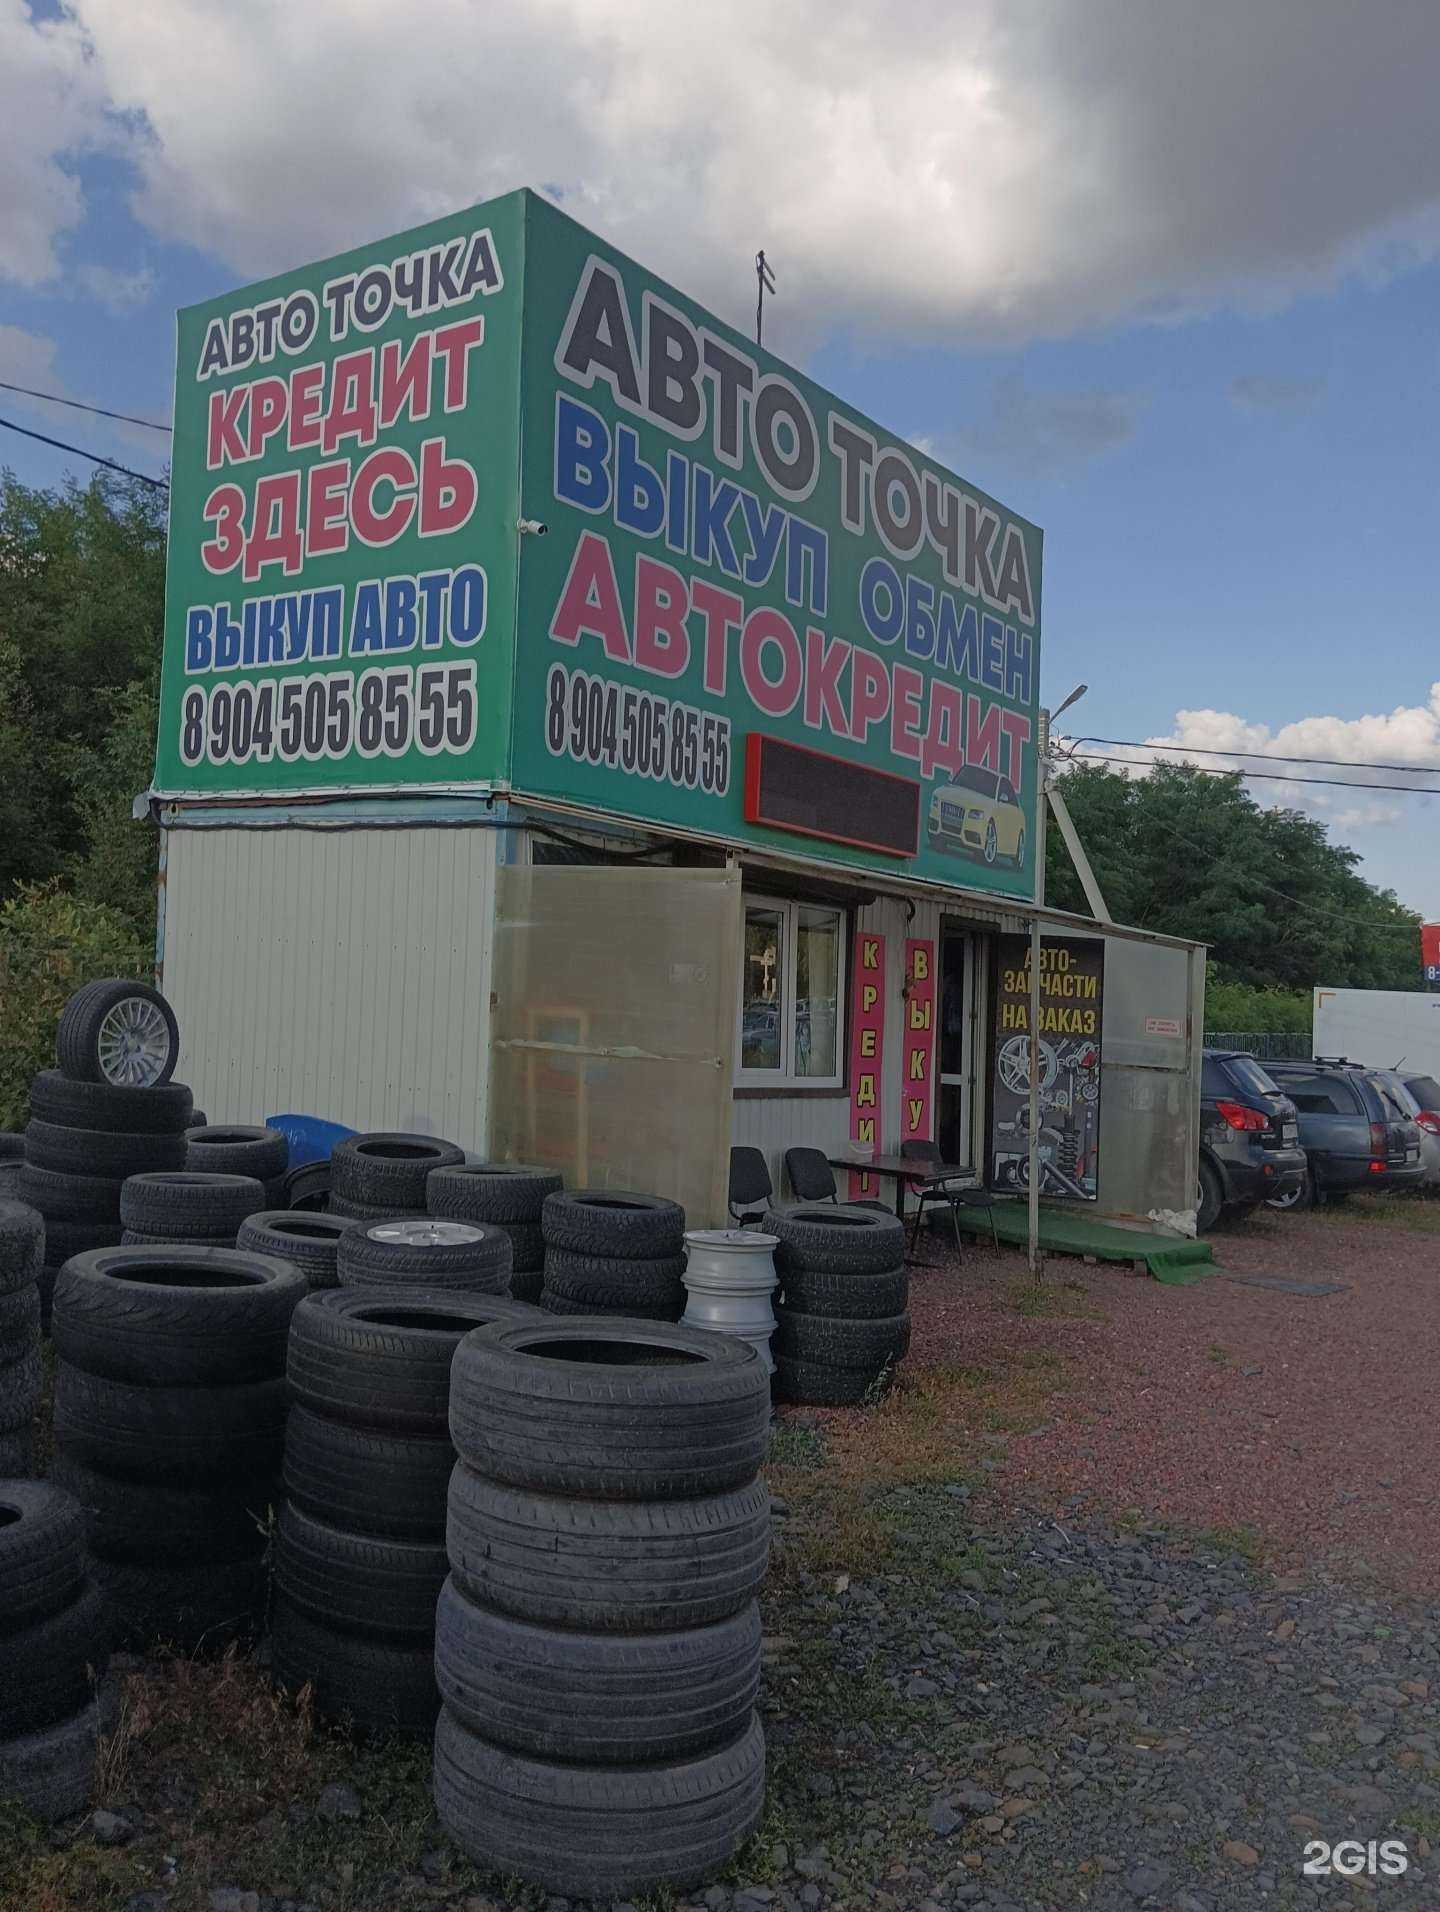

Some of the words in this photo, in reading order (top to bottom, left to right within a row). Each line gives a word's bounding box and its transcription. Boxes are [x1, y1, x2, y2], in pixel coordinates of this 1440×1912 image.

[198, 291, 317, 379] АВТО
[324, 231, 501, 340] ТОЧКА
[207, 316, 483, 469] КРЕДИТ
[556, 257, 818, 498] АВТО
[829, 412, 1033, 624] ТОЧКА
[202, 438, 477, 581] ЗДЕСЬ
[555, 391, 827, 617] ВЫКУП
[860, 557, 1032, 704] ОБМЕН
[186, 586, 343, 674] ВЫКУП
[351, 565, 487, 655] АВТО
[550, 531, 1030, 793] АВТОКРЕДИТ
[1002, 1003, 1028, 1030] НА
